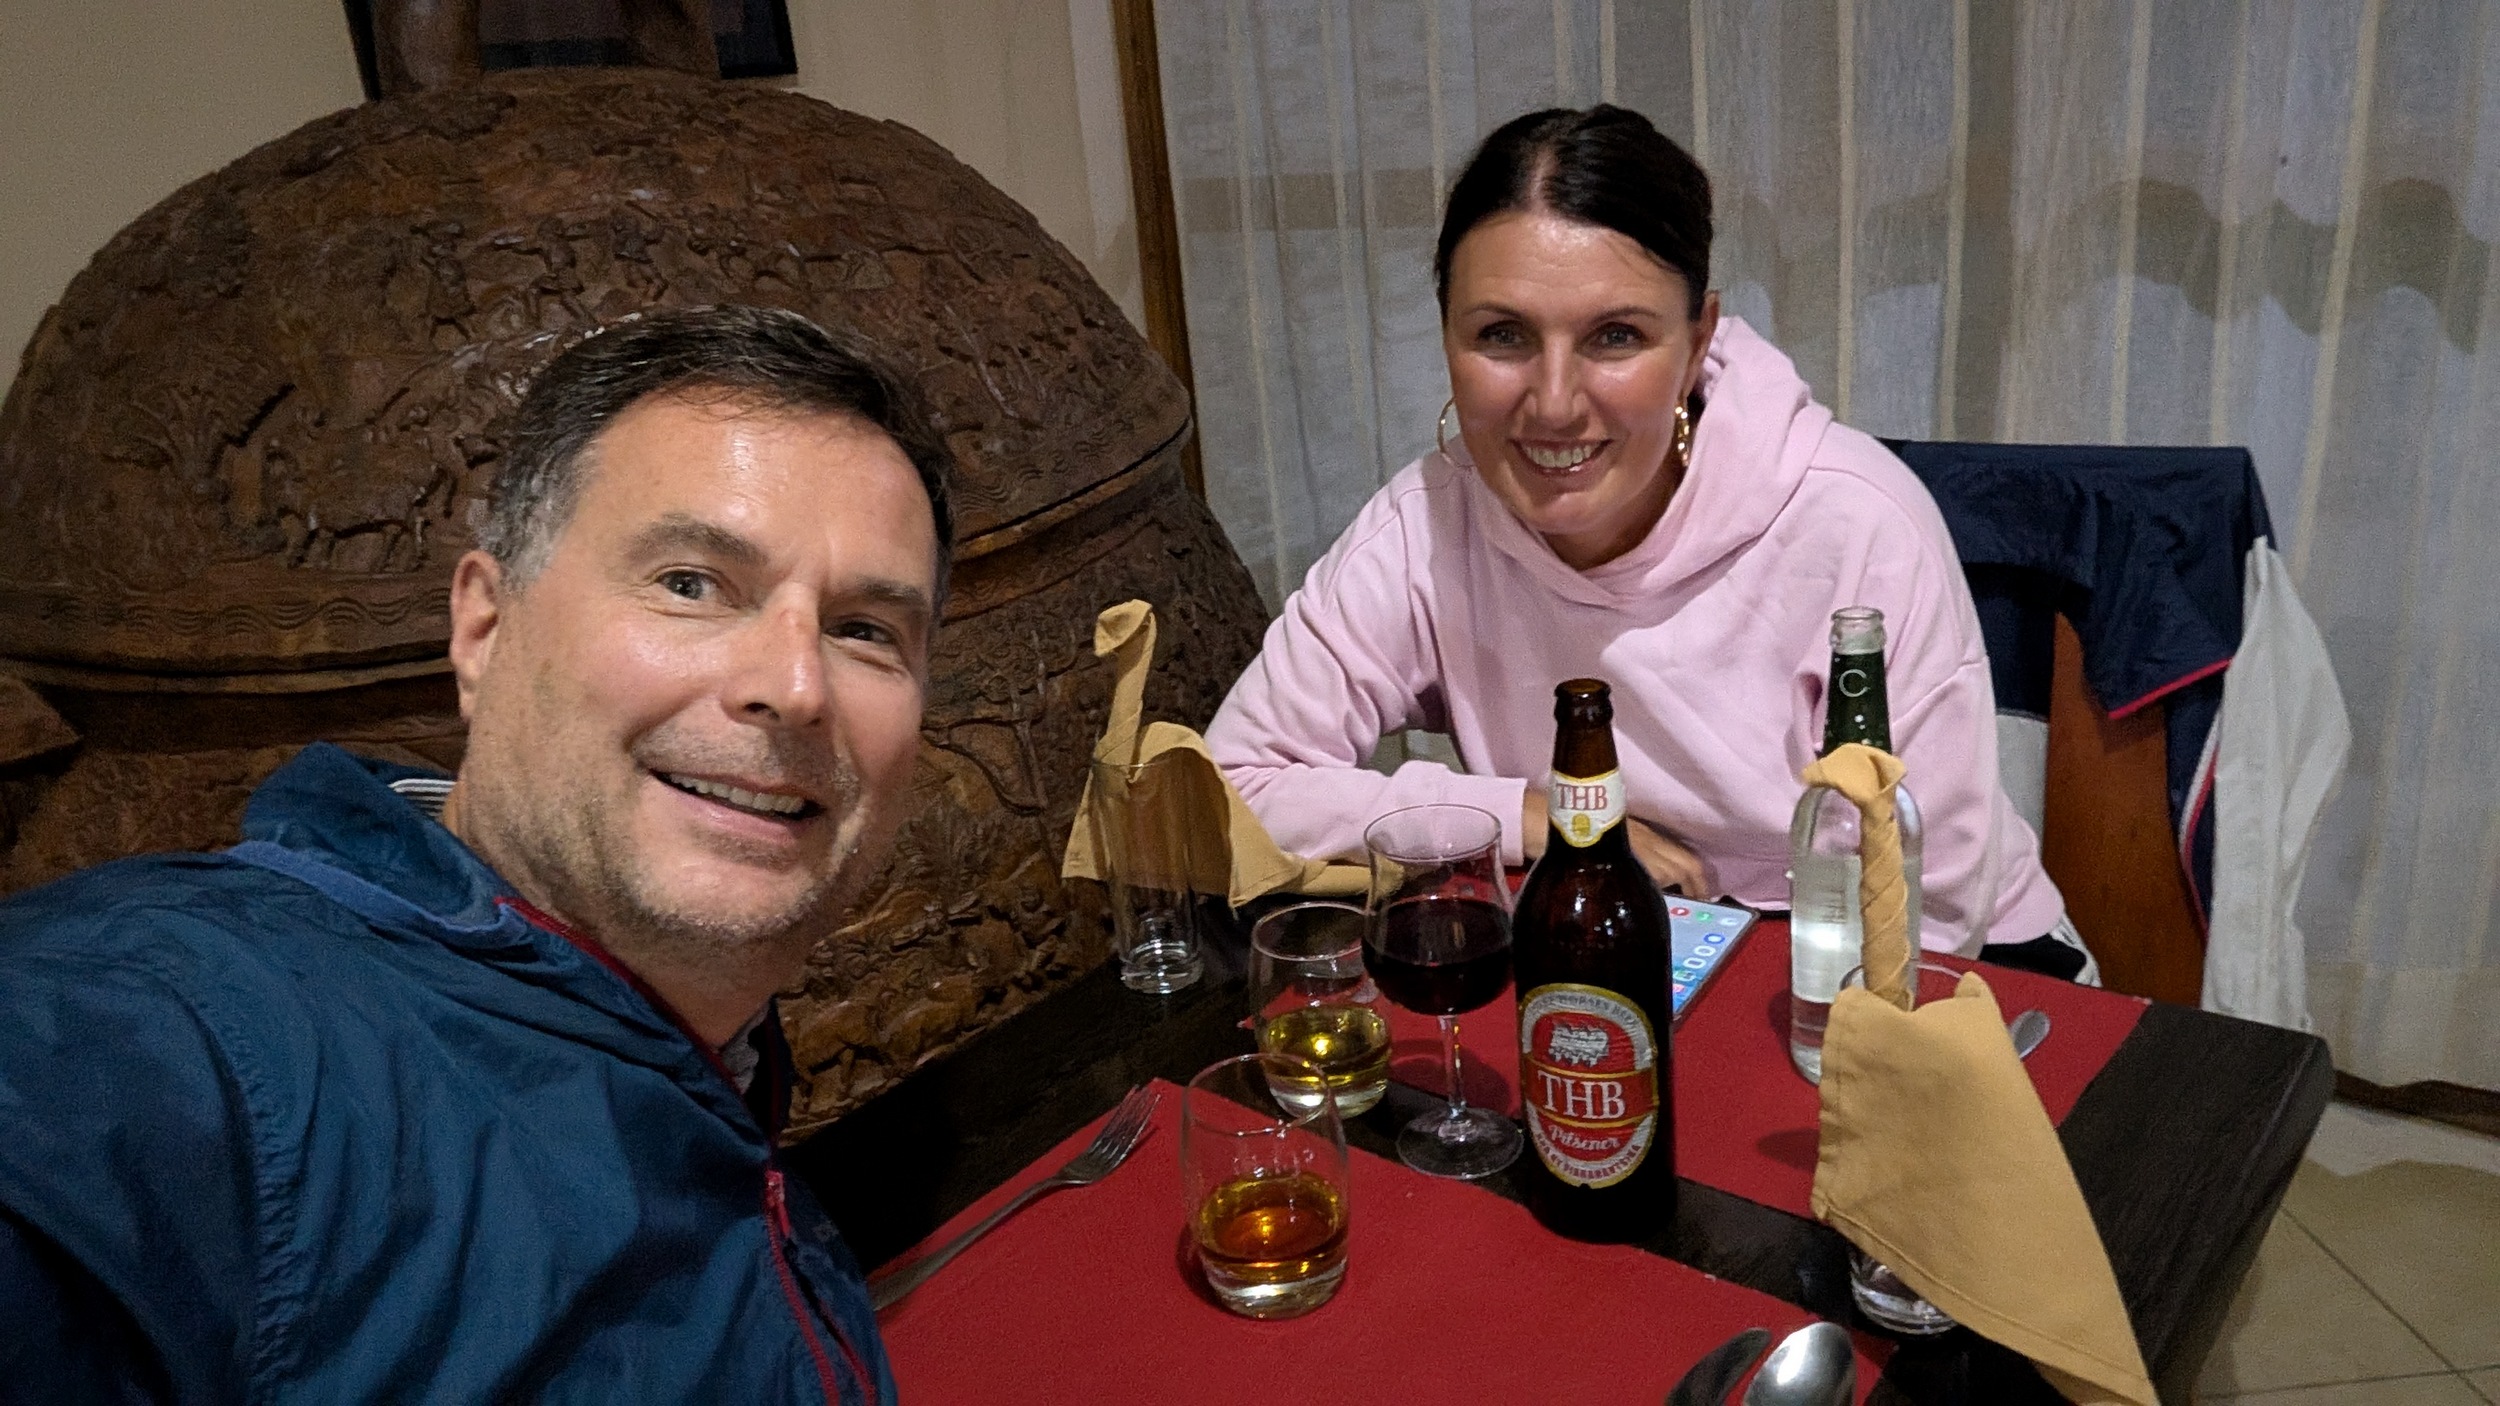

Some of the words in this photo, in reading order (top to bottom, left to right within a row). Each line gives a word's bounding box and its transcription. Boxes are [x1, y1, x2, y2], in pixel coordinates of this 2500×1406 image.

[1839, 669, 1868, 697] C
[1556, 783, 1608, 811] THB
[1537, 1070, 1626, 1120] THB
[1547, 1124, 1620, 1151] Pilsener
